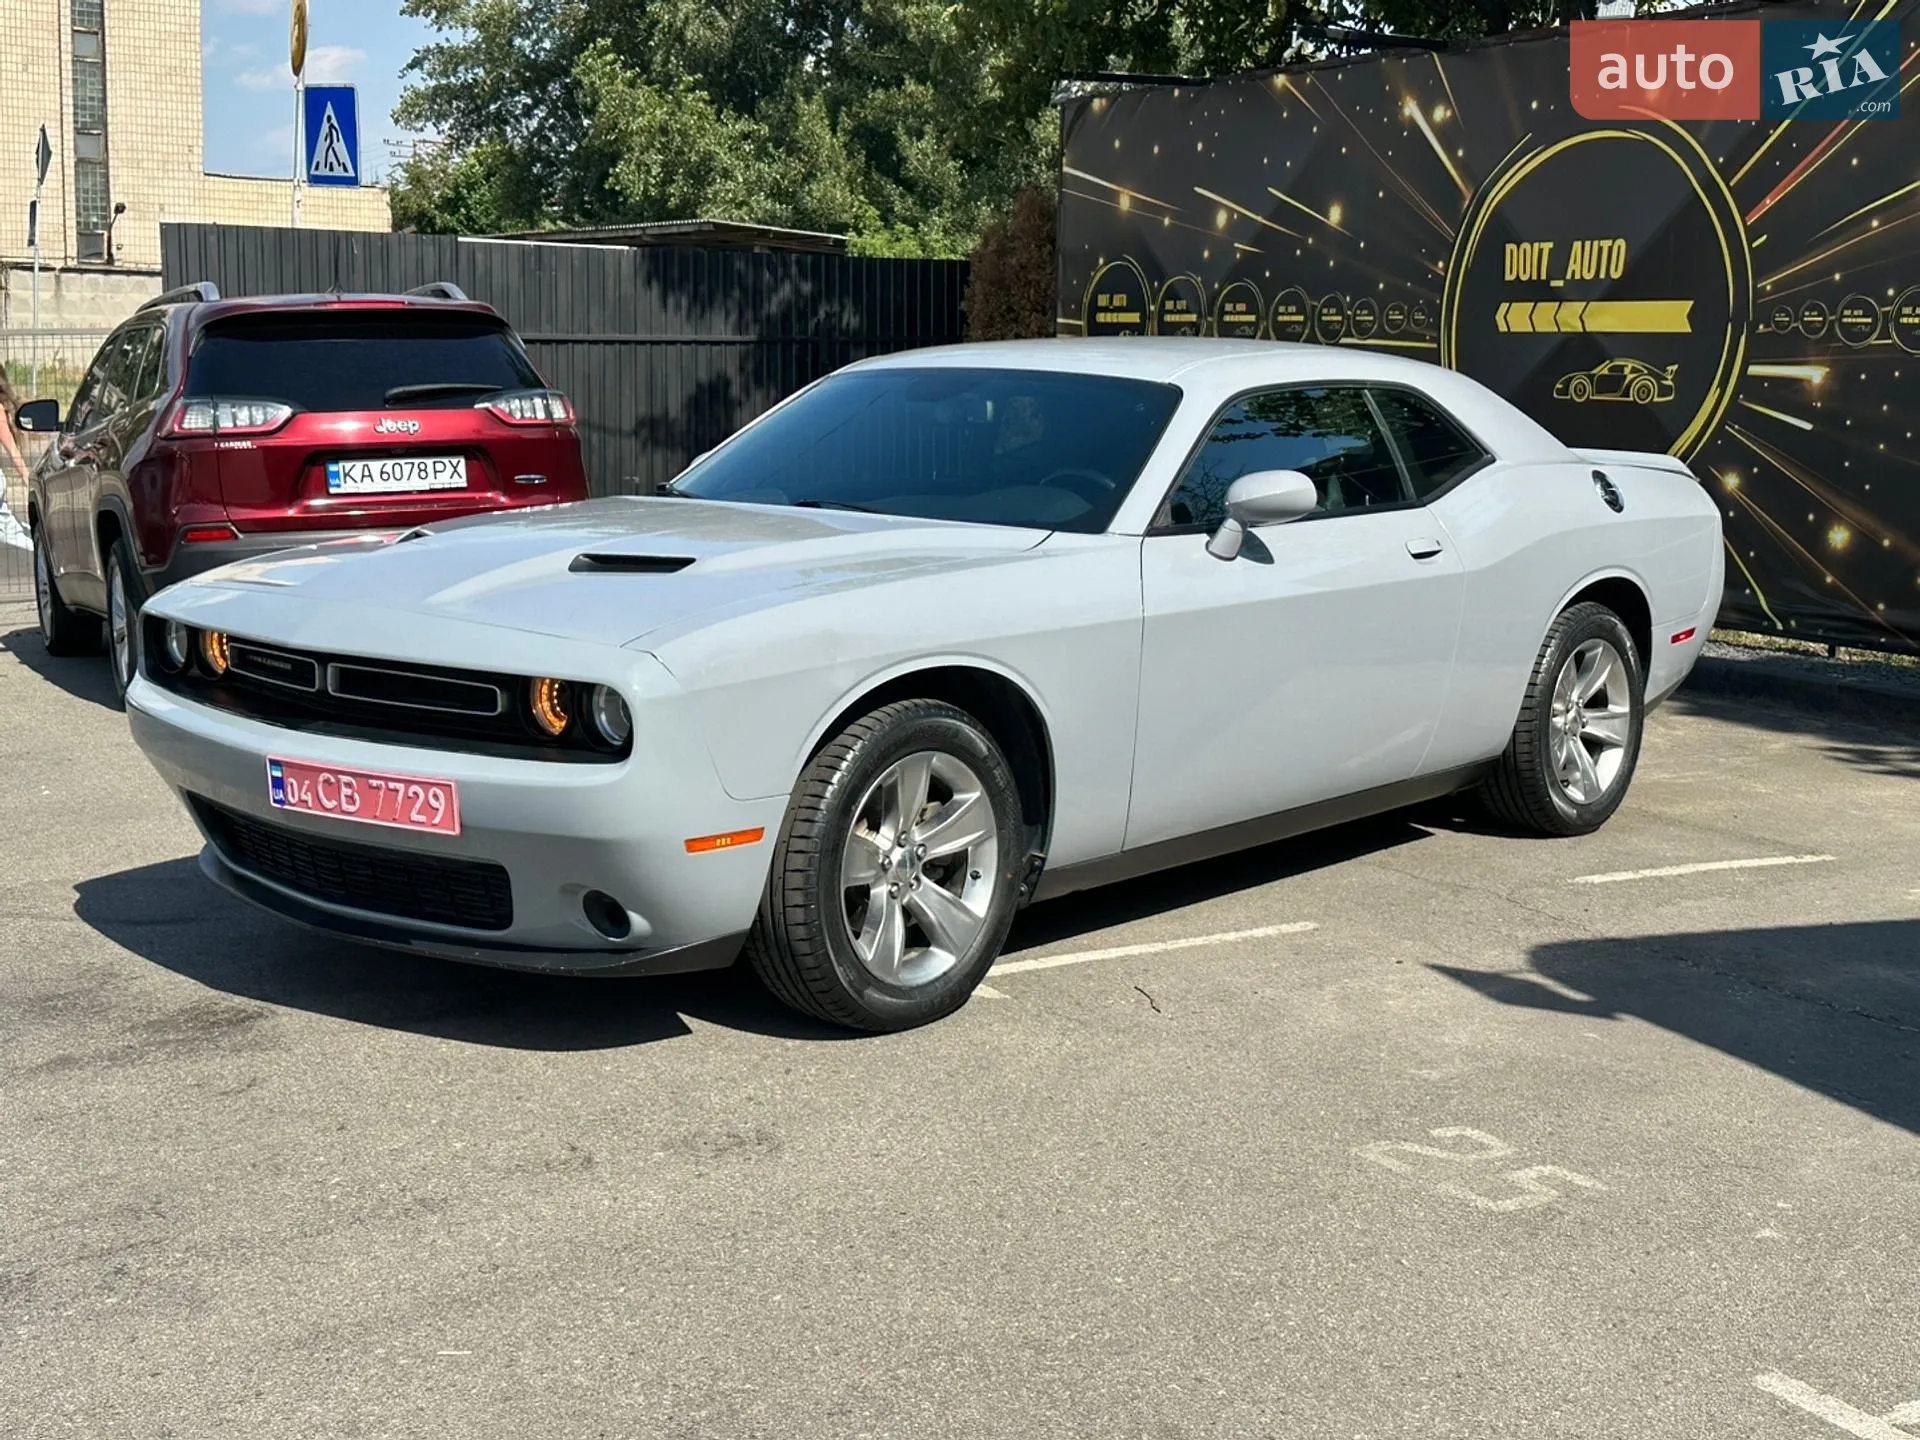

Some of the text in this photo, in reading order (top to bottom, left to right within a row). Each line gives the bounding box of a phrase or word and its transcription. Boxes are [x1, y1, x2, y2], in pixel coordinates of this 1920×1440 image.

[1504, 238, 1627, 287] DOIT_AUTO
[374, 418, 420, 435] Jeep
[342, 459, 463, 484] KA 6078 PX
[286, 772, 446, 826] 04 CB 7729
